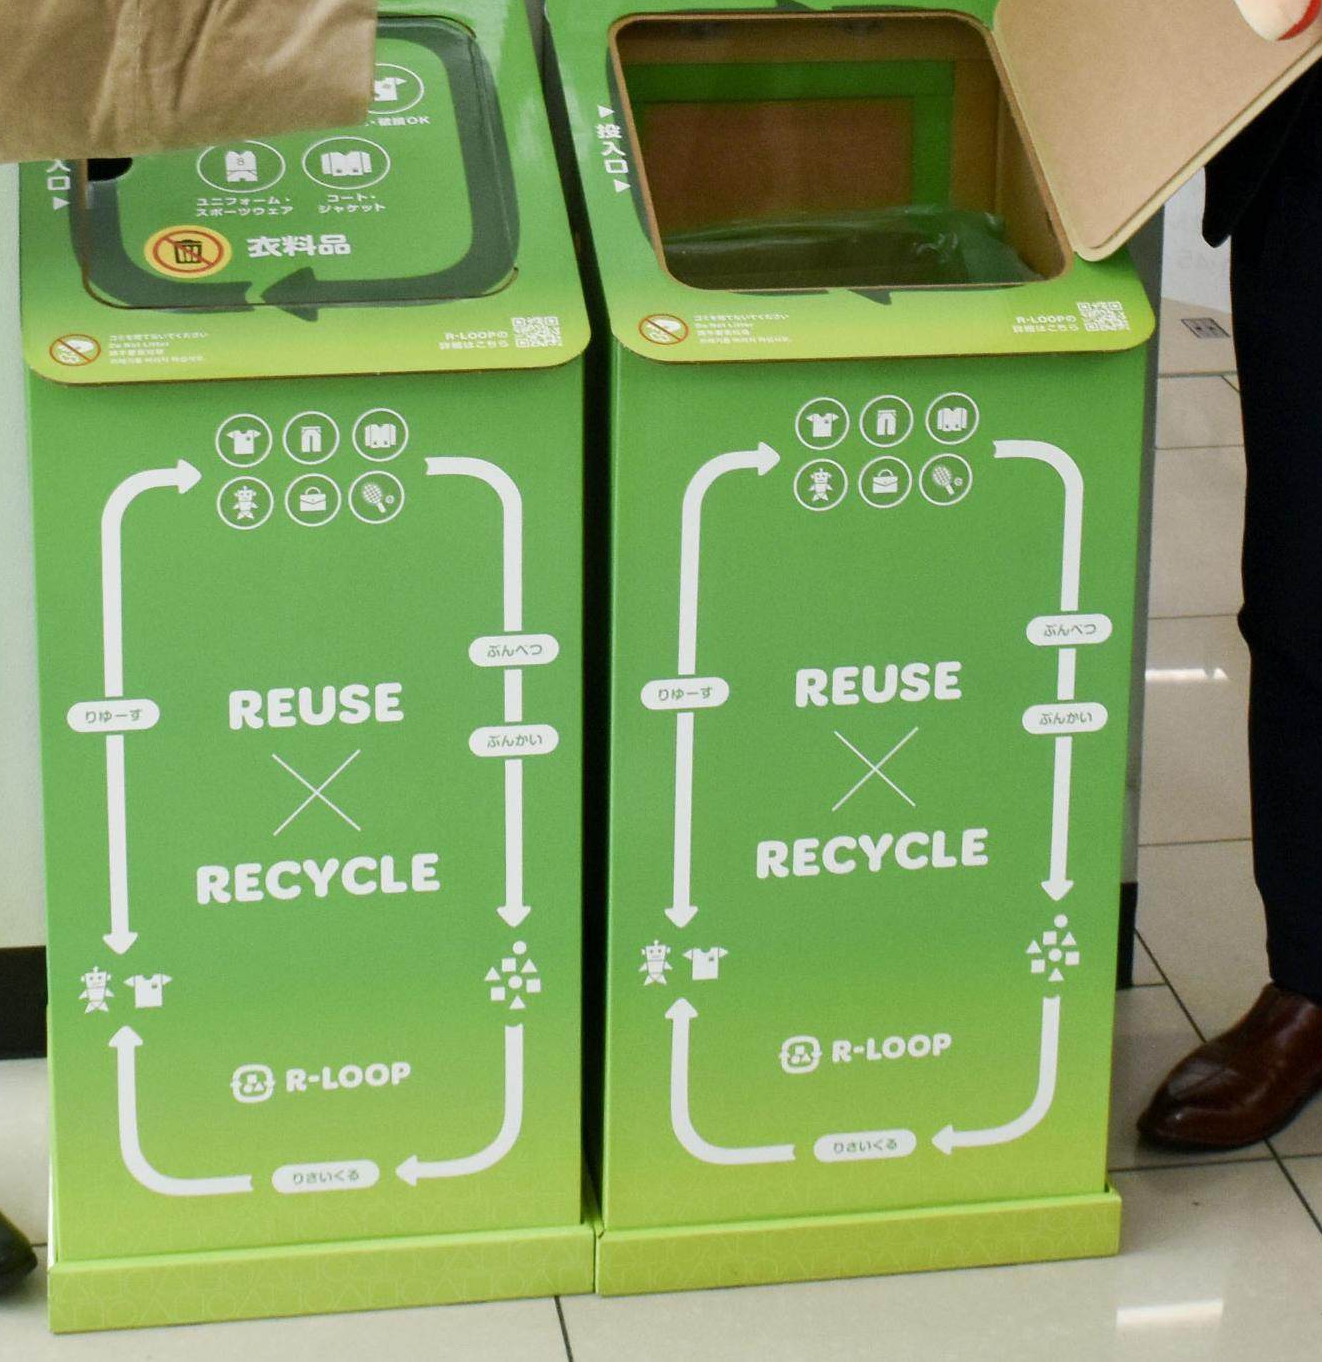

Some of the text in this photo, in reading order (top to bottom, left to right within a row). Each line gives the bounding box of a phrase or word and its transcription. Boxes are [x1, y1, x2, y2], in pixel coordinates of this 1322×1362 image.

[596, 123, 629, 173] 投入口
[196, 206, 294, 217] スポーツウェア
[318, 203, 386, 214] ジャケット
[247, 234, 351, 258] 衣料品
[795, 661, 962, 708] REUSE
[228, 682, 404, 730] REUSE
[1038, 710, 1094, 726] ぶんかい
[486, 732, 543, 748] ぶんかい
[756, 828, 989, 879] RECYCLE
[196, 853, 440, 905] RECYCLE
[832, 1033, 952, 1063] R-LOOP
[286, 1062, 411, 1092] R-LOOP
[833, 1138, 898, 1154] りさいくる
[292, 1168, 360, 1185] りさいくる
